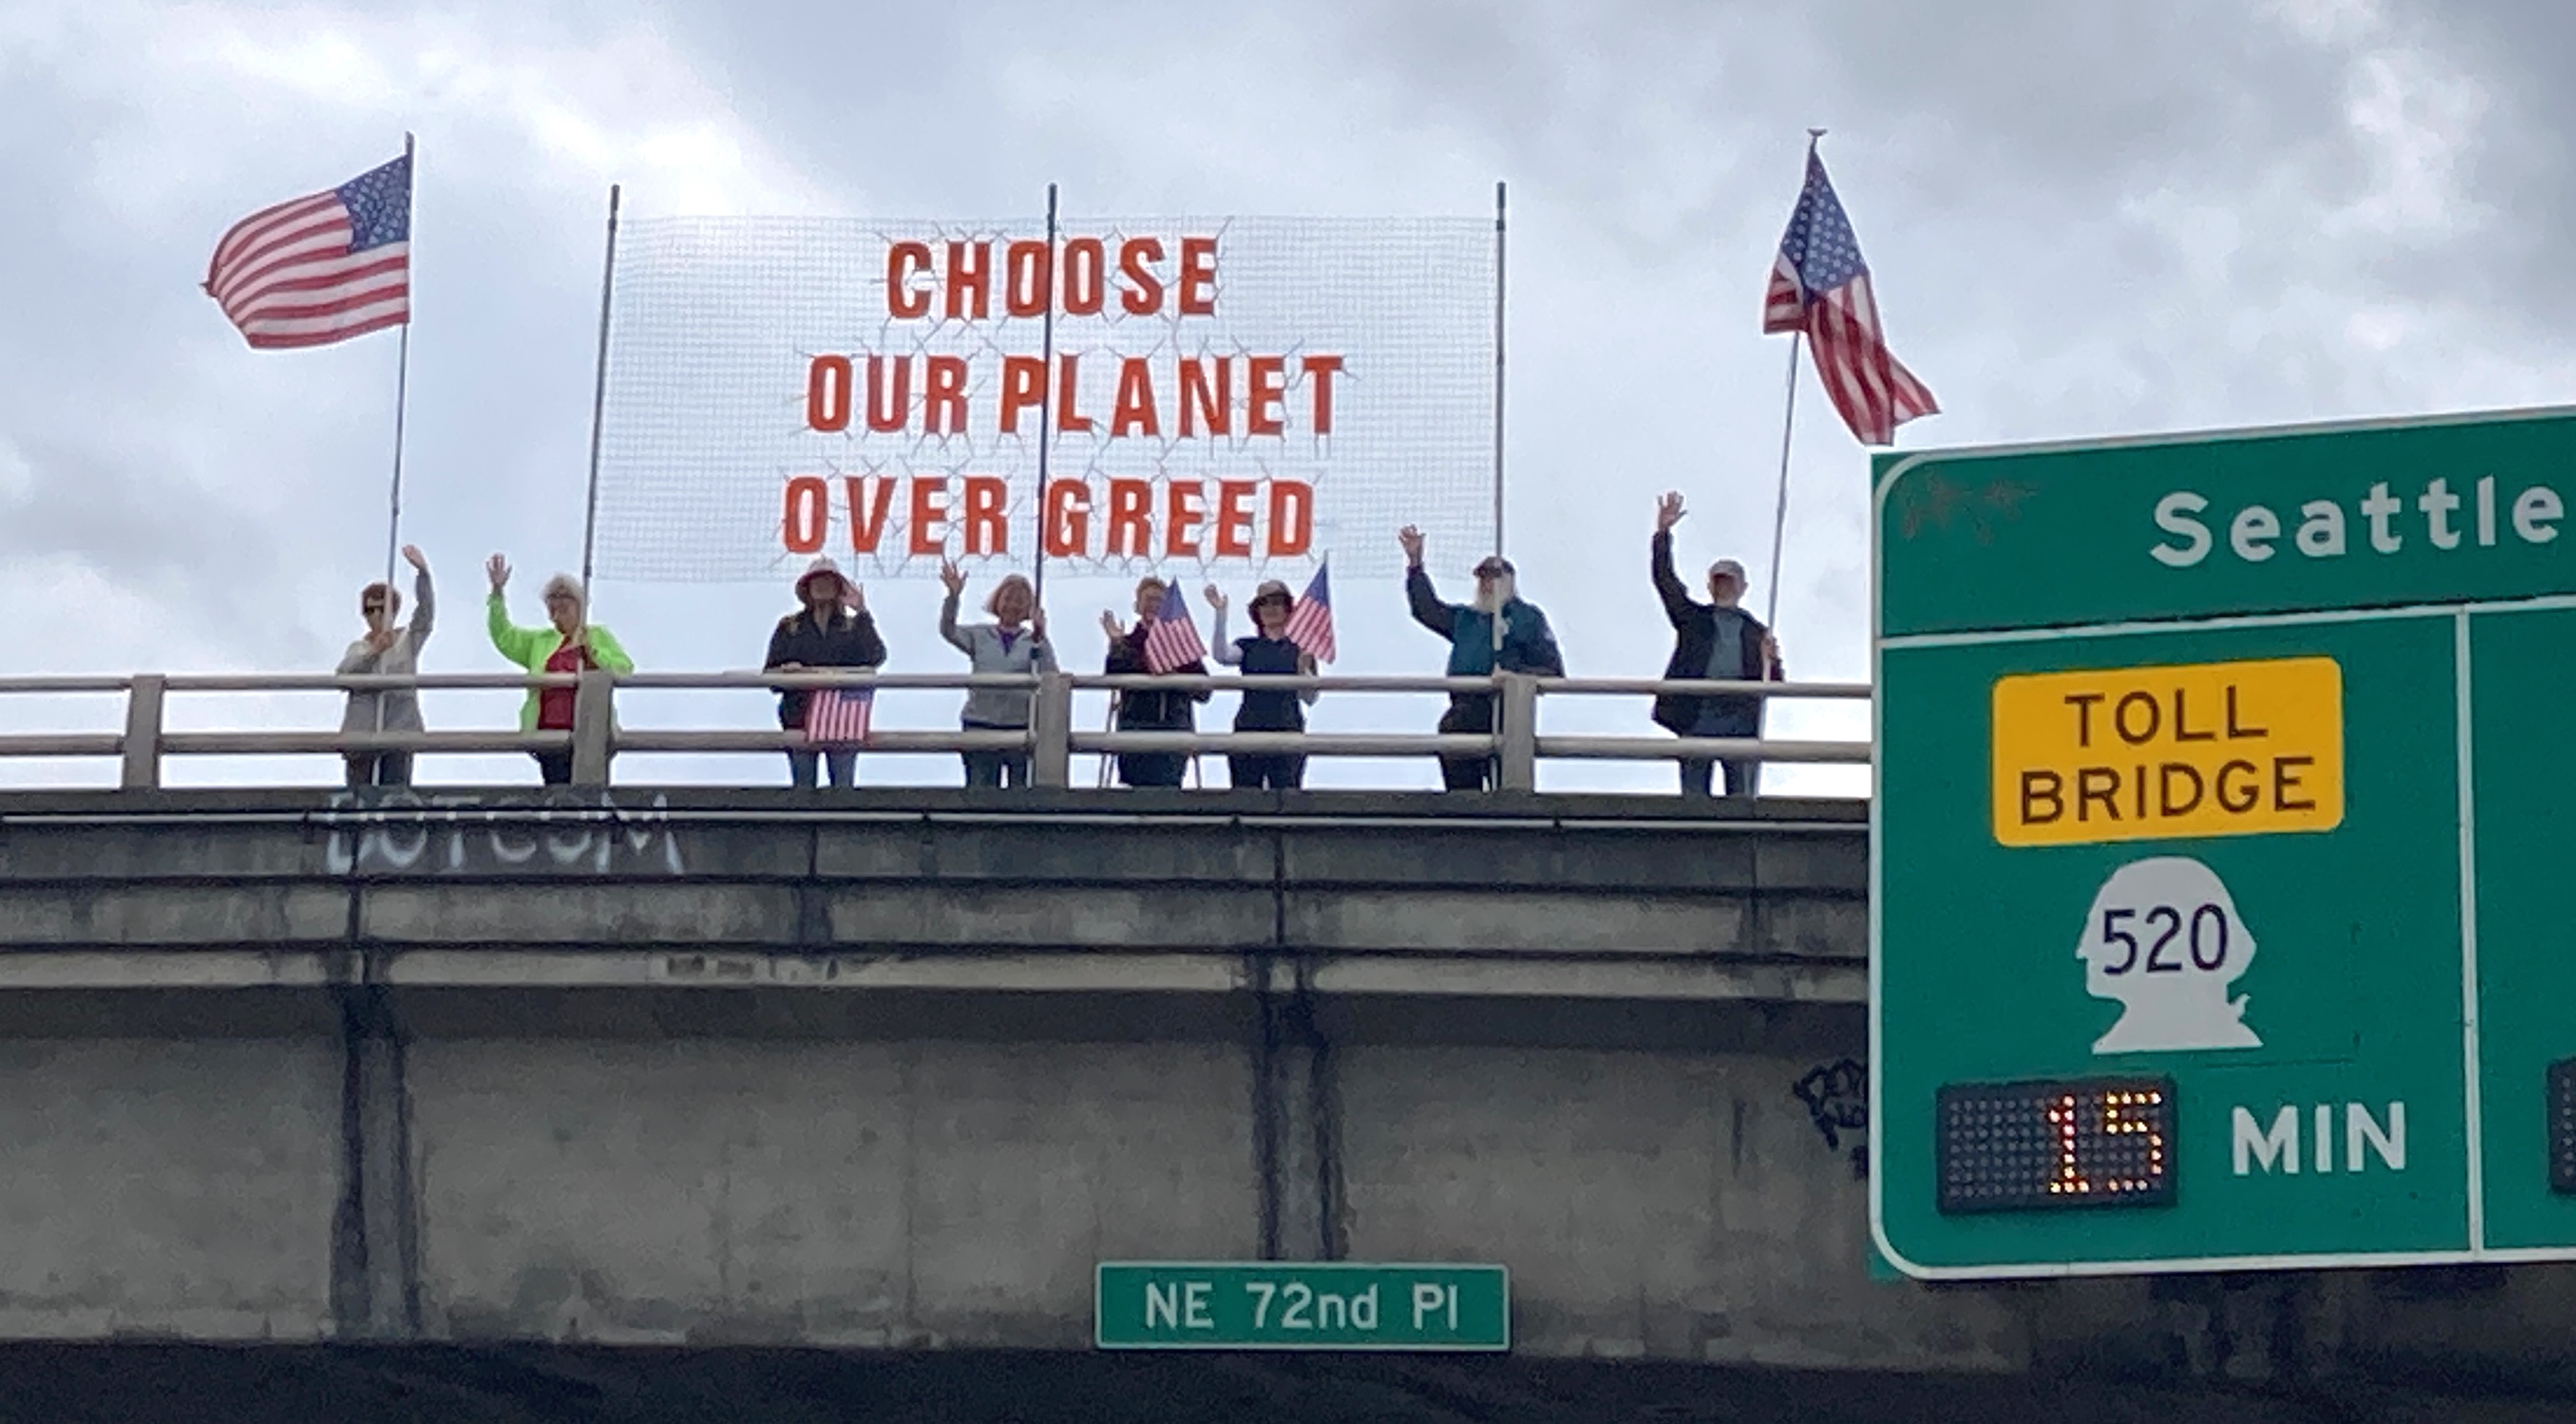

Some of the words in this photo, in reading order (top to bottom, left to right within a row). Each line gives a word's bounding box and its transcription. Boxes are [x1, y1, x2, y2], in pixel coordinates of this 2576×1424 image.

[888, 238, 1217, 319] CHOOSE
[808, 355, 968, 433] OUR
[1000, 355, 1343, 437] PLANET
[783, 476, 1008, 554] OVER
[1045, 479, 1313, 557] GREED
[2150, 474, 2564, 567] Seattle
[2065, 686, 2268, 746] TOLL
[2021, 756, 2316, 825] BRIDGE
[2103, 904, 2227, 975] 520
[2049, 1093, 2163, 1193] 15
[2233, 1102, 2406, 1175] MIN
[1145, 1282, 1215, 1330] NE
[1246, 1282, 1378, 1330] 72nd
[1413, 1284, 1458, 1330] Pl
